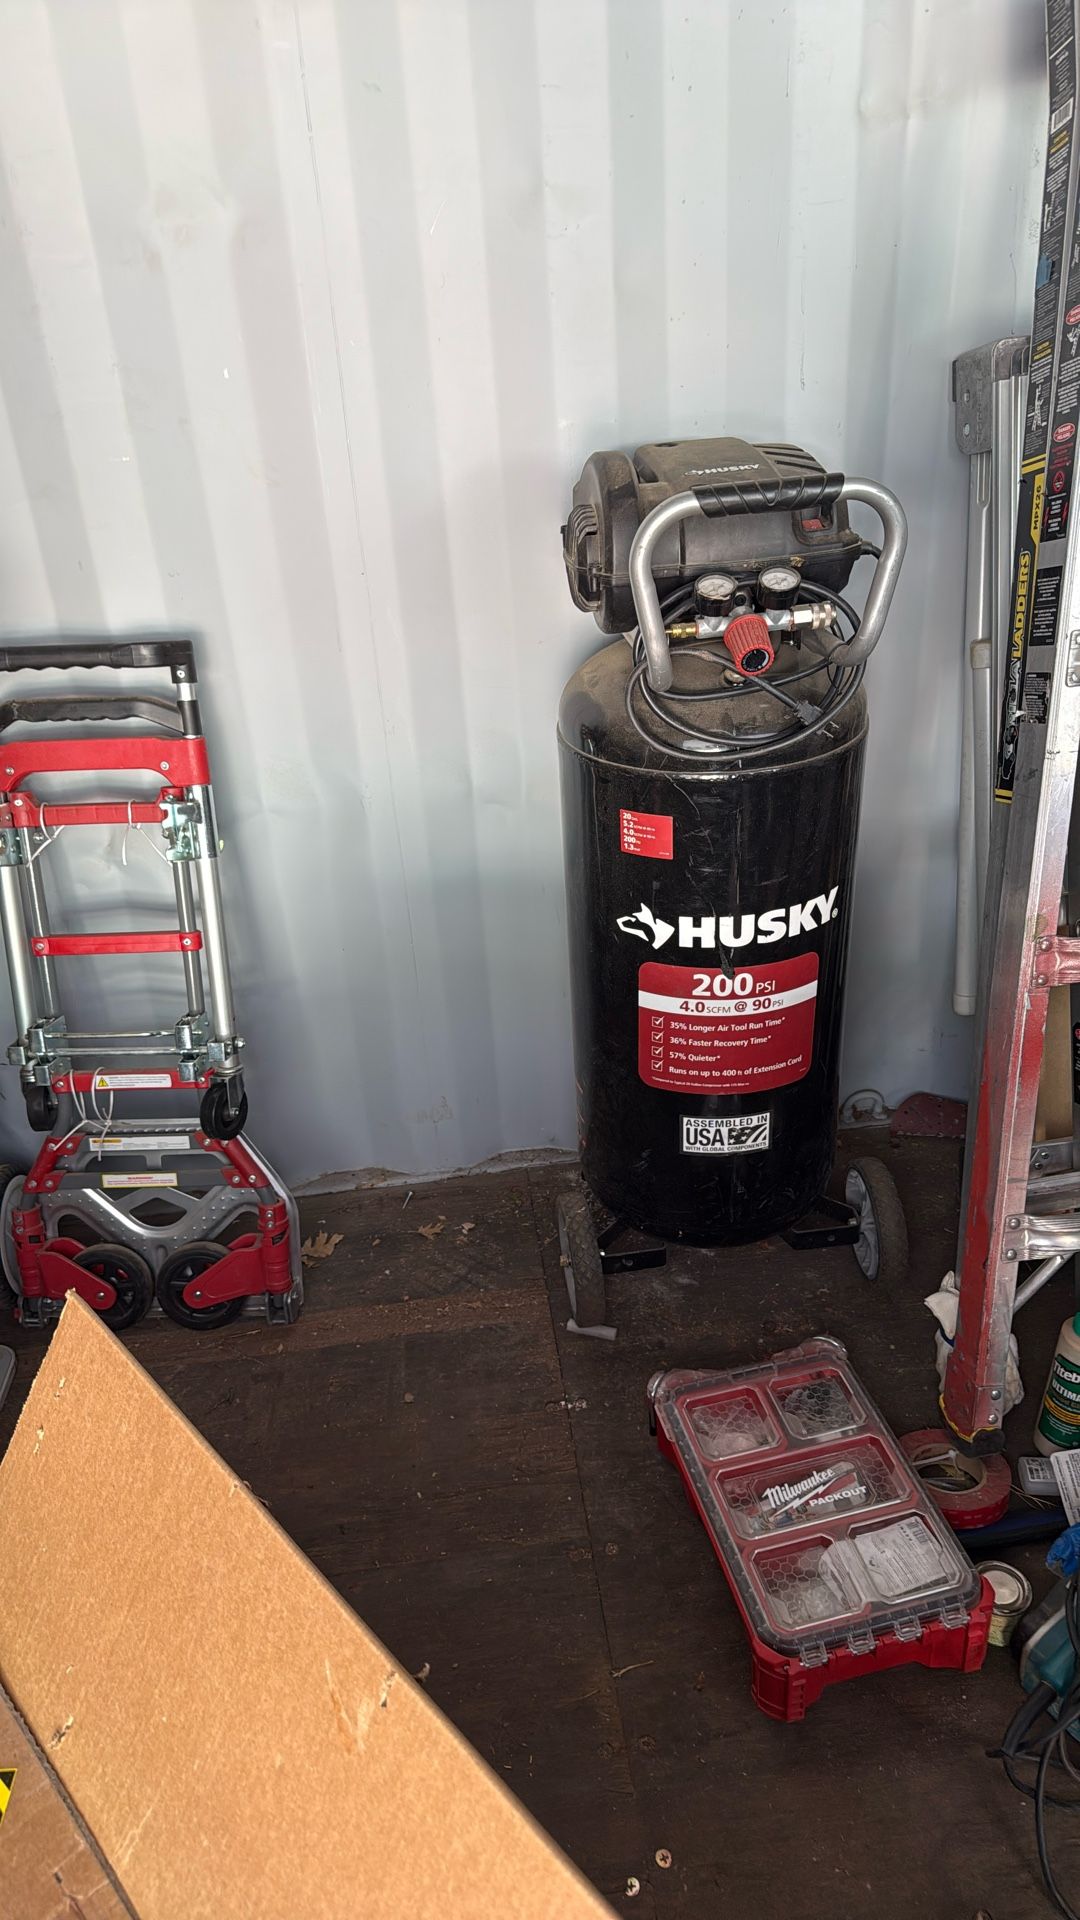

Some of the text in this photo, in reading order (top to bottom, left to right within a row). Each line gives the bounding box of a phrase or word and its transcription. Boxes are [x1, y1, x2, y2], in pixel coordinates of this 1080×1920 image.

[704, 464, 760, 474] HUSKY
[1011, 553, 1030, 659] LADDERS
[623, 835, 636, 843] 200
[678, 885, 839, 949] HUSKY
[691, 973, 753, 997] 200
[734, 1001, 748, 1012] @
[670, 1021, 687, 1030] 35%
[689, 1023, 716, 1033] Longer
[717, 1024, 729, 1032] Air
[731, 1022, 748, 1031] Tool
[670, 1036, 687, 1045] 36%
[688, 1038, 712, 1047] Faster
[714, 1038, 748, 1047] Recovery
[669, 1051, 686, 1060] 57%
[669, 1066, 687, 1075] Runs
[700, 1069, 710, 1078] up
[712, 1069, 720, 1077] to
[722, 1069, 737, 1077] 400
[744, 1067, 752, 1075] of
[753, 1062, 786, 1074] Extension
[787, 1054, 802, 1066] Cord
[685, 1114, 768, 1128] ASSEMBLED IN
[685, 1127, 725, 1146] USA
[727, 1141, 767, 1152] COMPONENTS
[762, 1468, 836, 1509] Milwaukee
[808, 1486, 867, 1507] PACKOUT
